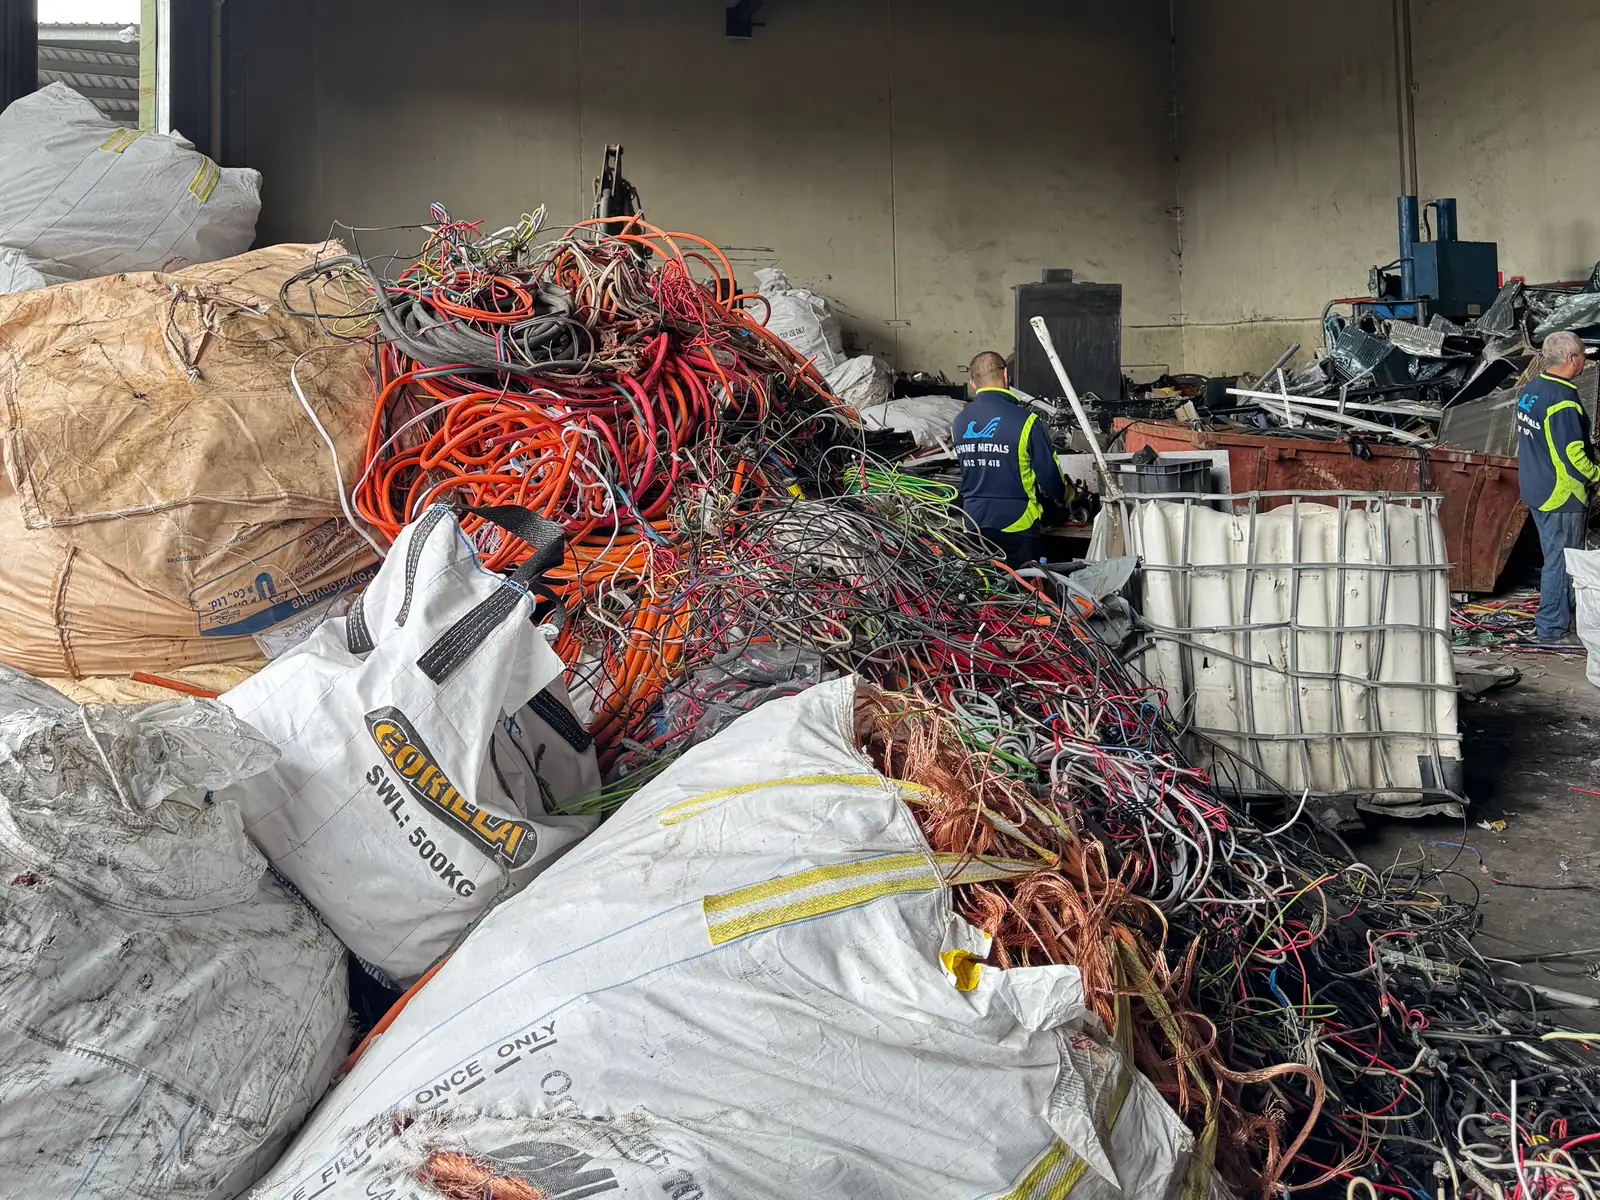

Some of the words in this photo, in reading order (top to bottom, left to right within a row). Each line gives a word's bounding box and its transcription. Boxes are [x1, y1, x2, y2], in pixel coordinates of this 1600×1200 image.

[977, 442, 1010, 454] METALS
[207, 596, 228, 610] Ltd.
[292, 569, 375, 609] Polypropylene
[373, 720, 527, 861] GORILLA
[366, 764, 411, 829] SWL:
[408, 826, 476, 898] 500KG
[415, 1060, 483, 1105] ONCE
[497, 1020, 556, 1058] ONLY
